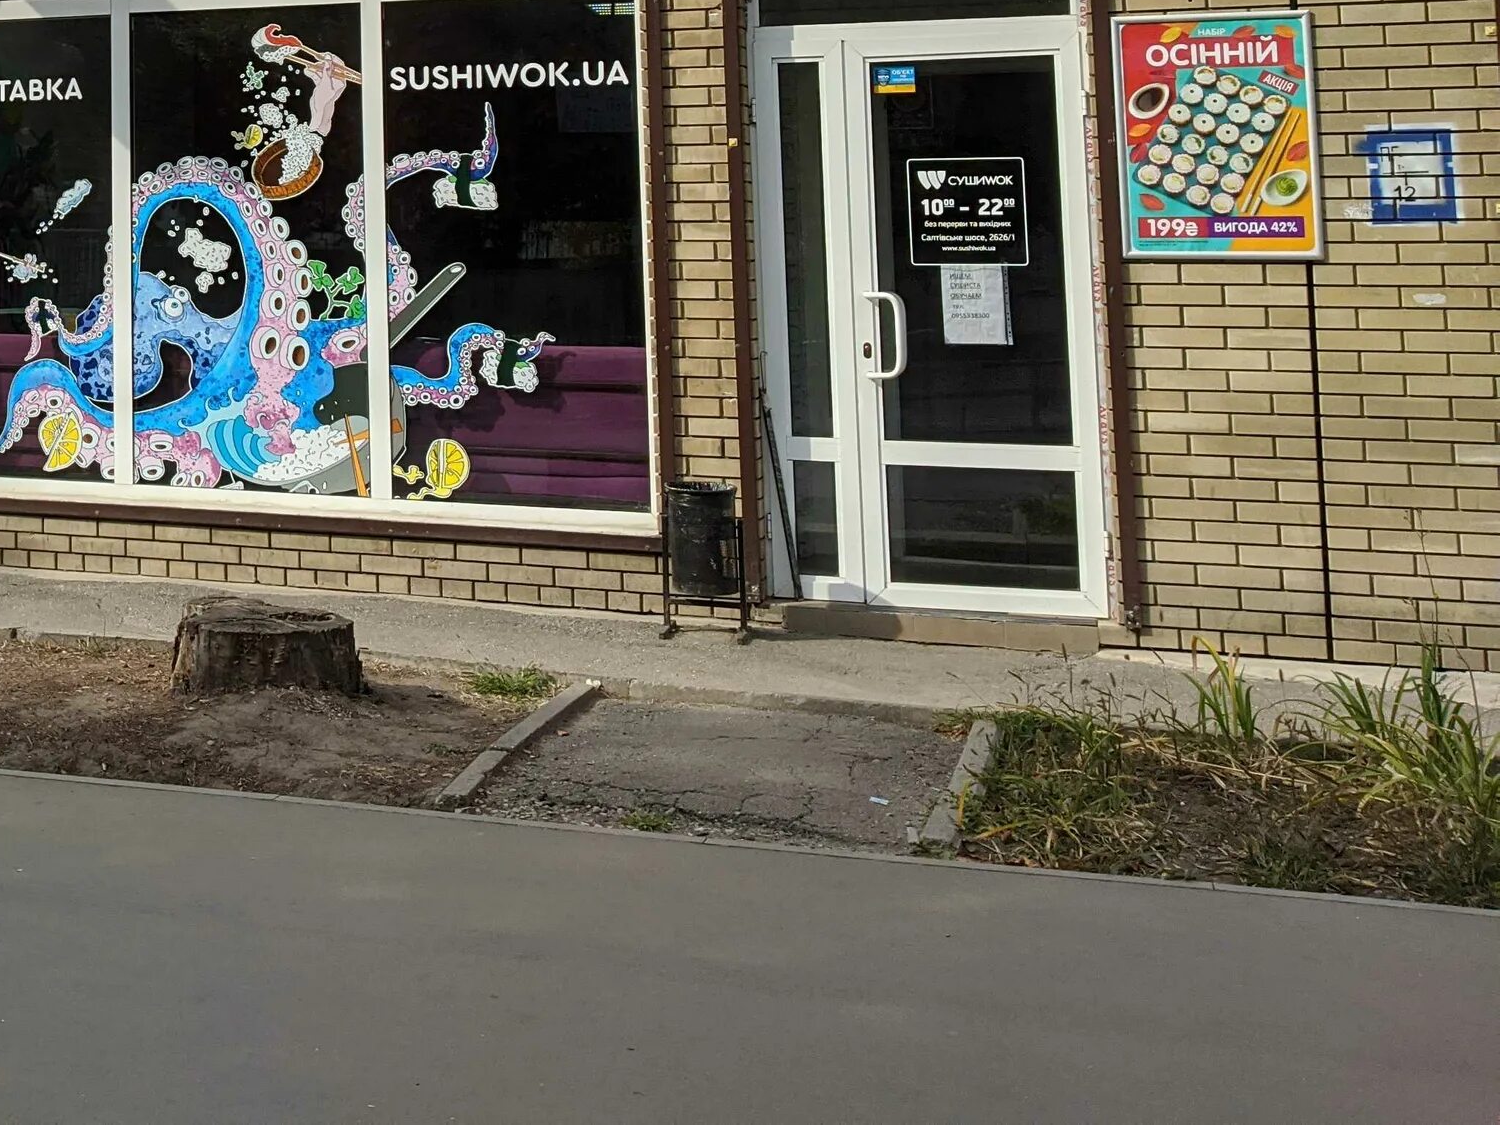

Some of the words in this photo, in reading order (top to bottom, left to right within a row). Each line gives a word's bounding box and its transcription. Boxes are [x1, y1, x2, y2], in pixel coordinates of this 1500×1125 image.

[1197, 28, 1226, 36] НАБІР
[1145, 35, 1279, 67] ОСІННІЙ
[390, 60, 630, 91] SUSHIWOK.UA
[1262, 73, 1295, 93] АКЦІЯ
[1394, 185, 1417, 202] 12
[924, 220, 937, 228] без
[1214, 221, 1269, 235] ВИГОДА
[1270, 221, 1298, 233] 42%
[921, 234, 963, 242] Салтівське
